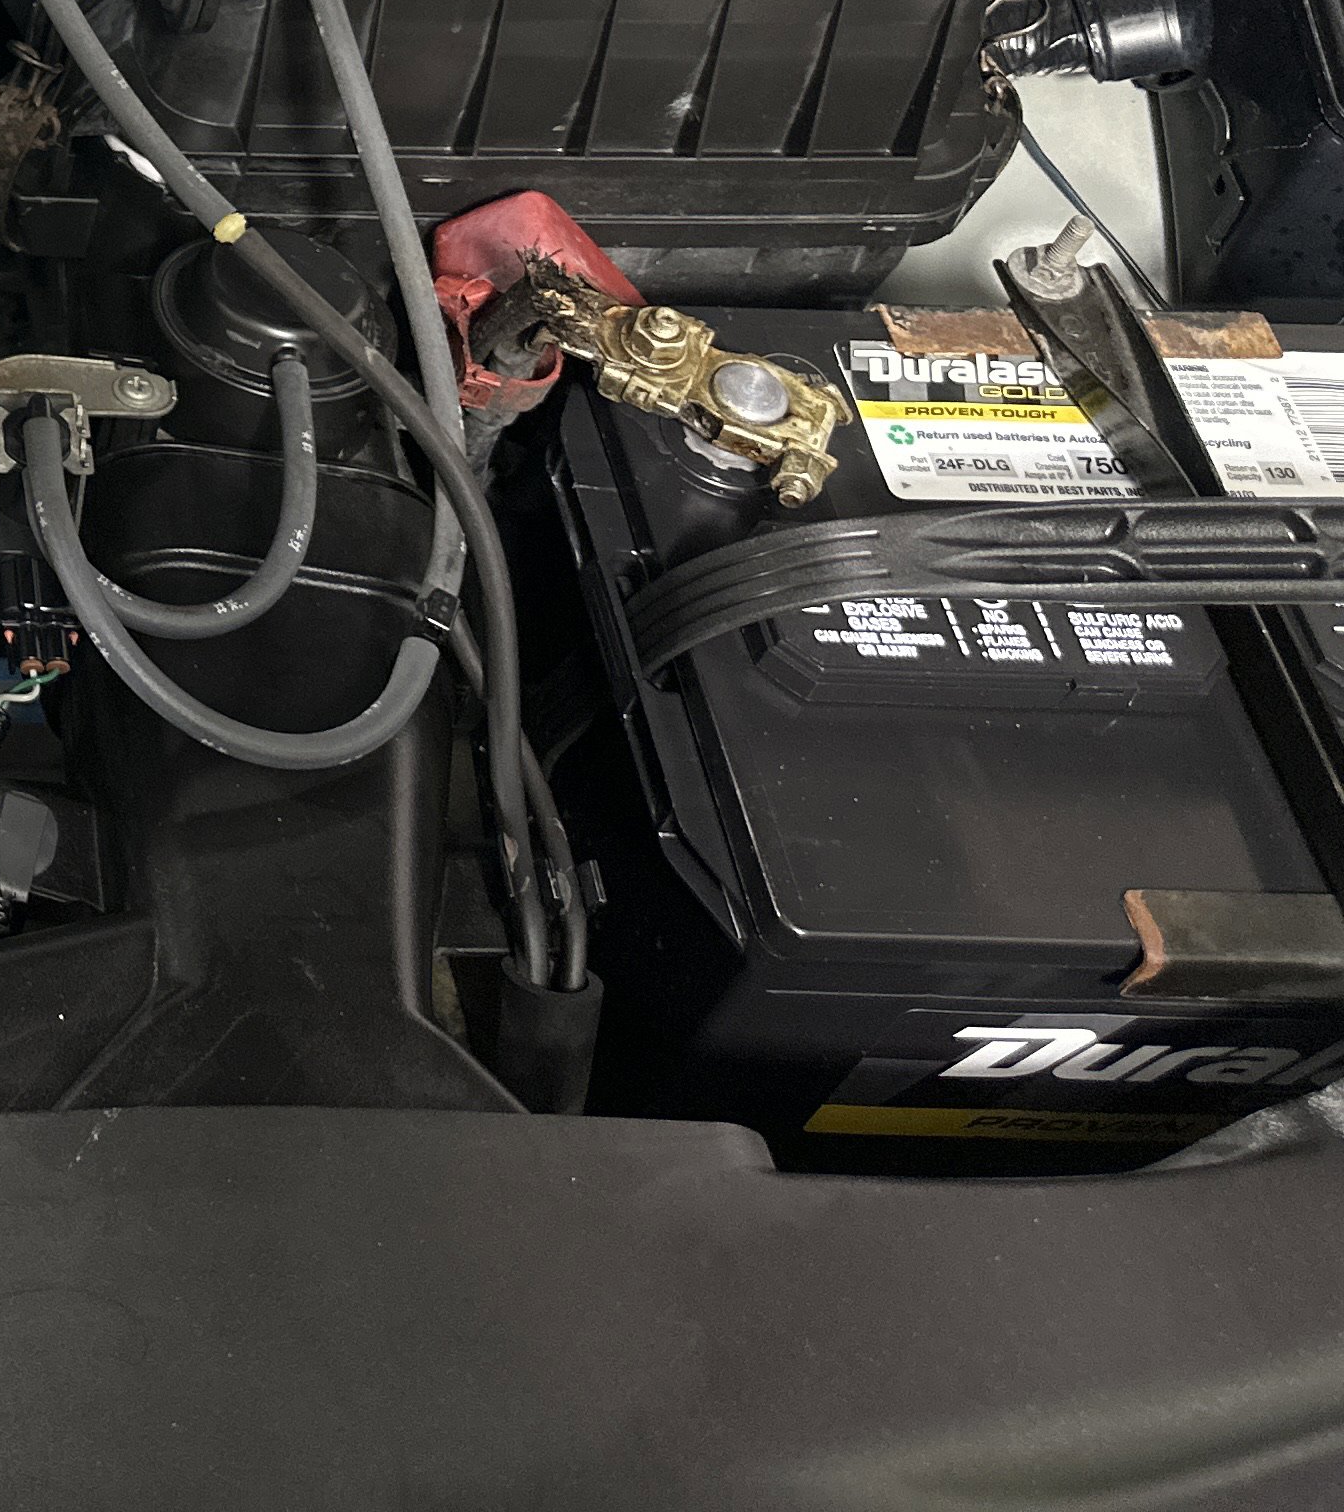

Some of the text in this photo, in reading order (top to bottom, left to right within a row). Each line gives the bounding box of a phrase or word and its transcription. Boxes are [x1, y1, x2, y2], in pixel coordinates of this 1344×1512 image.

[978, 385, 1068, 400] GOLD
[904, 406, 1058, 419] PROVEN TOUGH
[1277, 395, 1301, 426] 77387
[916, 430, 960, 440] Return
[963, 431, 993, 441] used
[995, 432, 1050, 442] batteries
[1053, 433, 1065, 443] to
[1296, 428, 1320, 462] 21112
[935, 458, 1011, 472] 24F-DLG
[1077, 456, 1129, 475] 750
[1265, 467, 1295, 479] 130
[969, 482, 1038, 494] DISTRIBUTED
[1040, 484, 1055, 494] BY
[1057, 485, 1086, 496] BEST
[841, 601, 928, 619] EXPLOSIVE
[981, 609, 1009, 624] NO
[848, 616, 902, 632] GASES
[1068, 611, 1183, 630] SULFURIC ACID
[1074, 626, 1144, 639] CAN CAUSE
